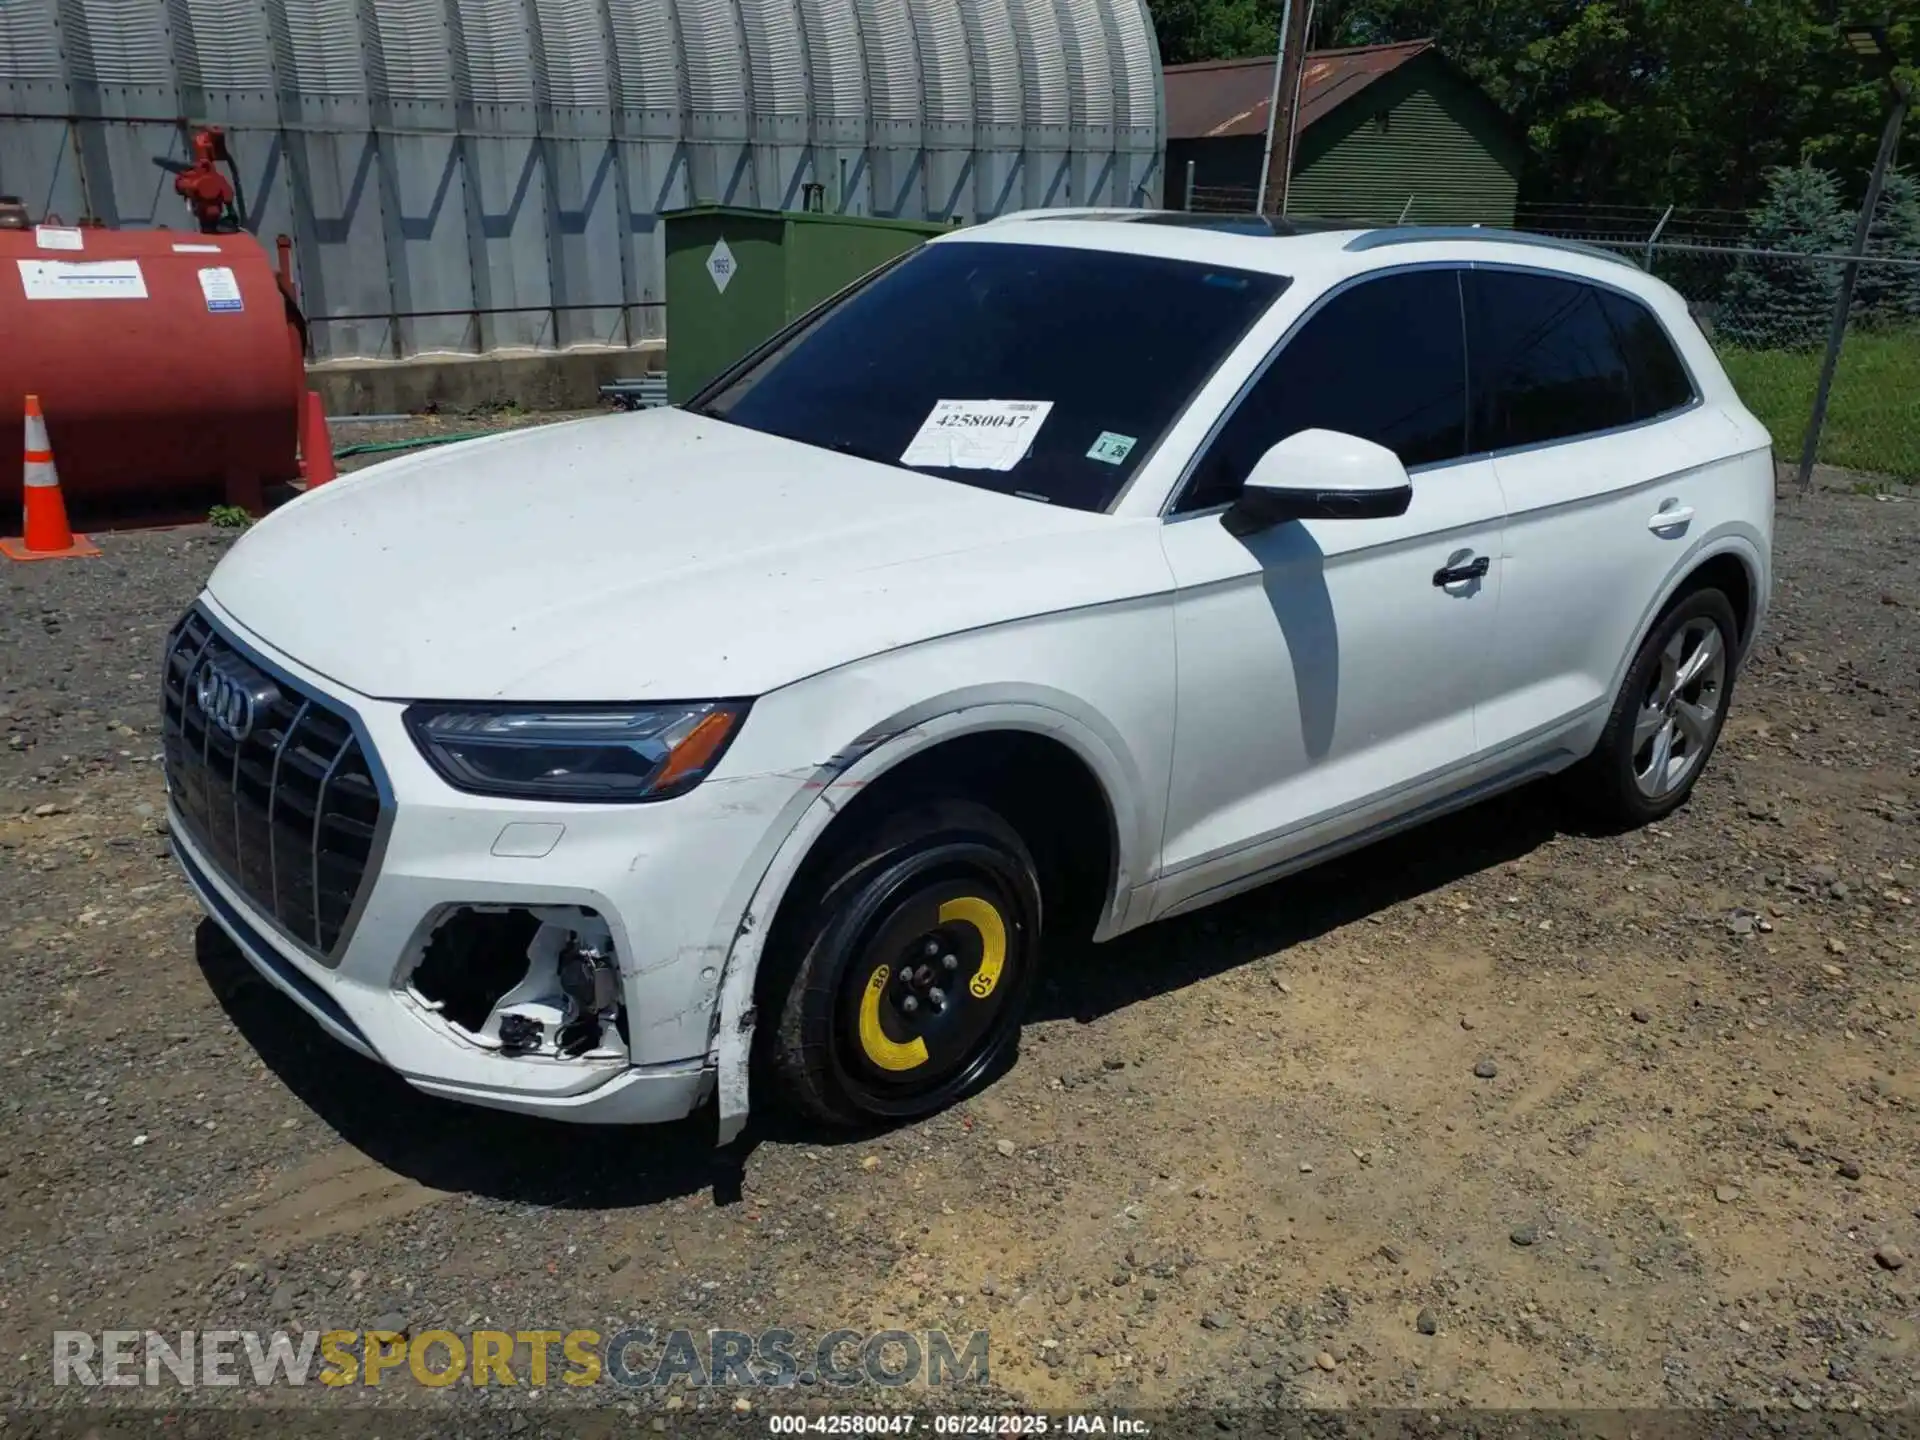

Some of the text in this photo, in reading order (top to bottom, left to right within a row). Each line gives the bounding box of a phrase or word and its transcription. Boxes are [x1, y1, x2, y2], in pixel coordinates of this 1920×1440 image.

[936, 413, 1030, 428] 42580047
[1111, 444, 1128, 458] 26
[971, 972, 992, 996] 50
